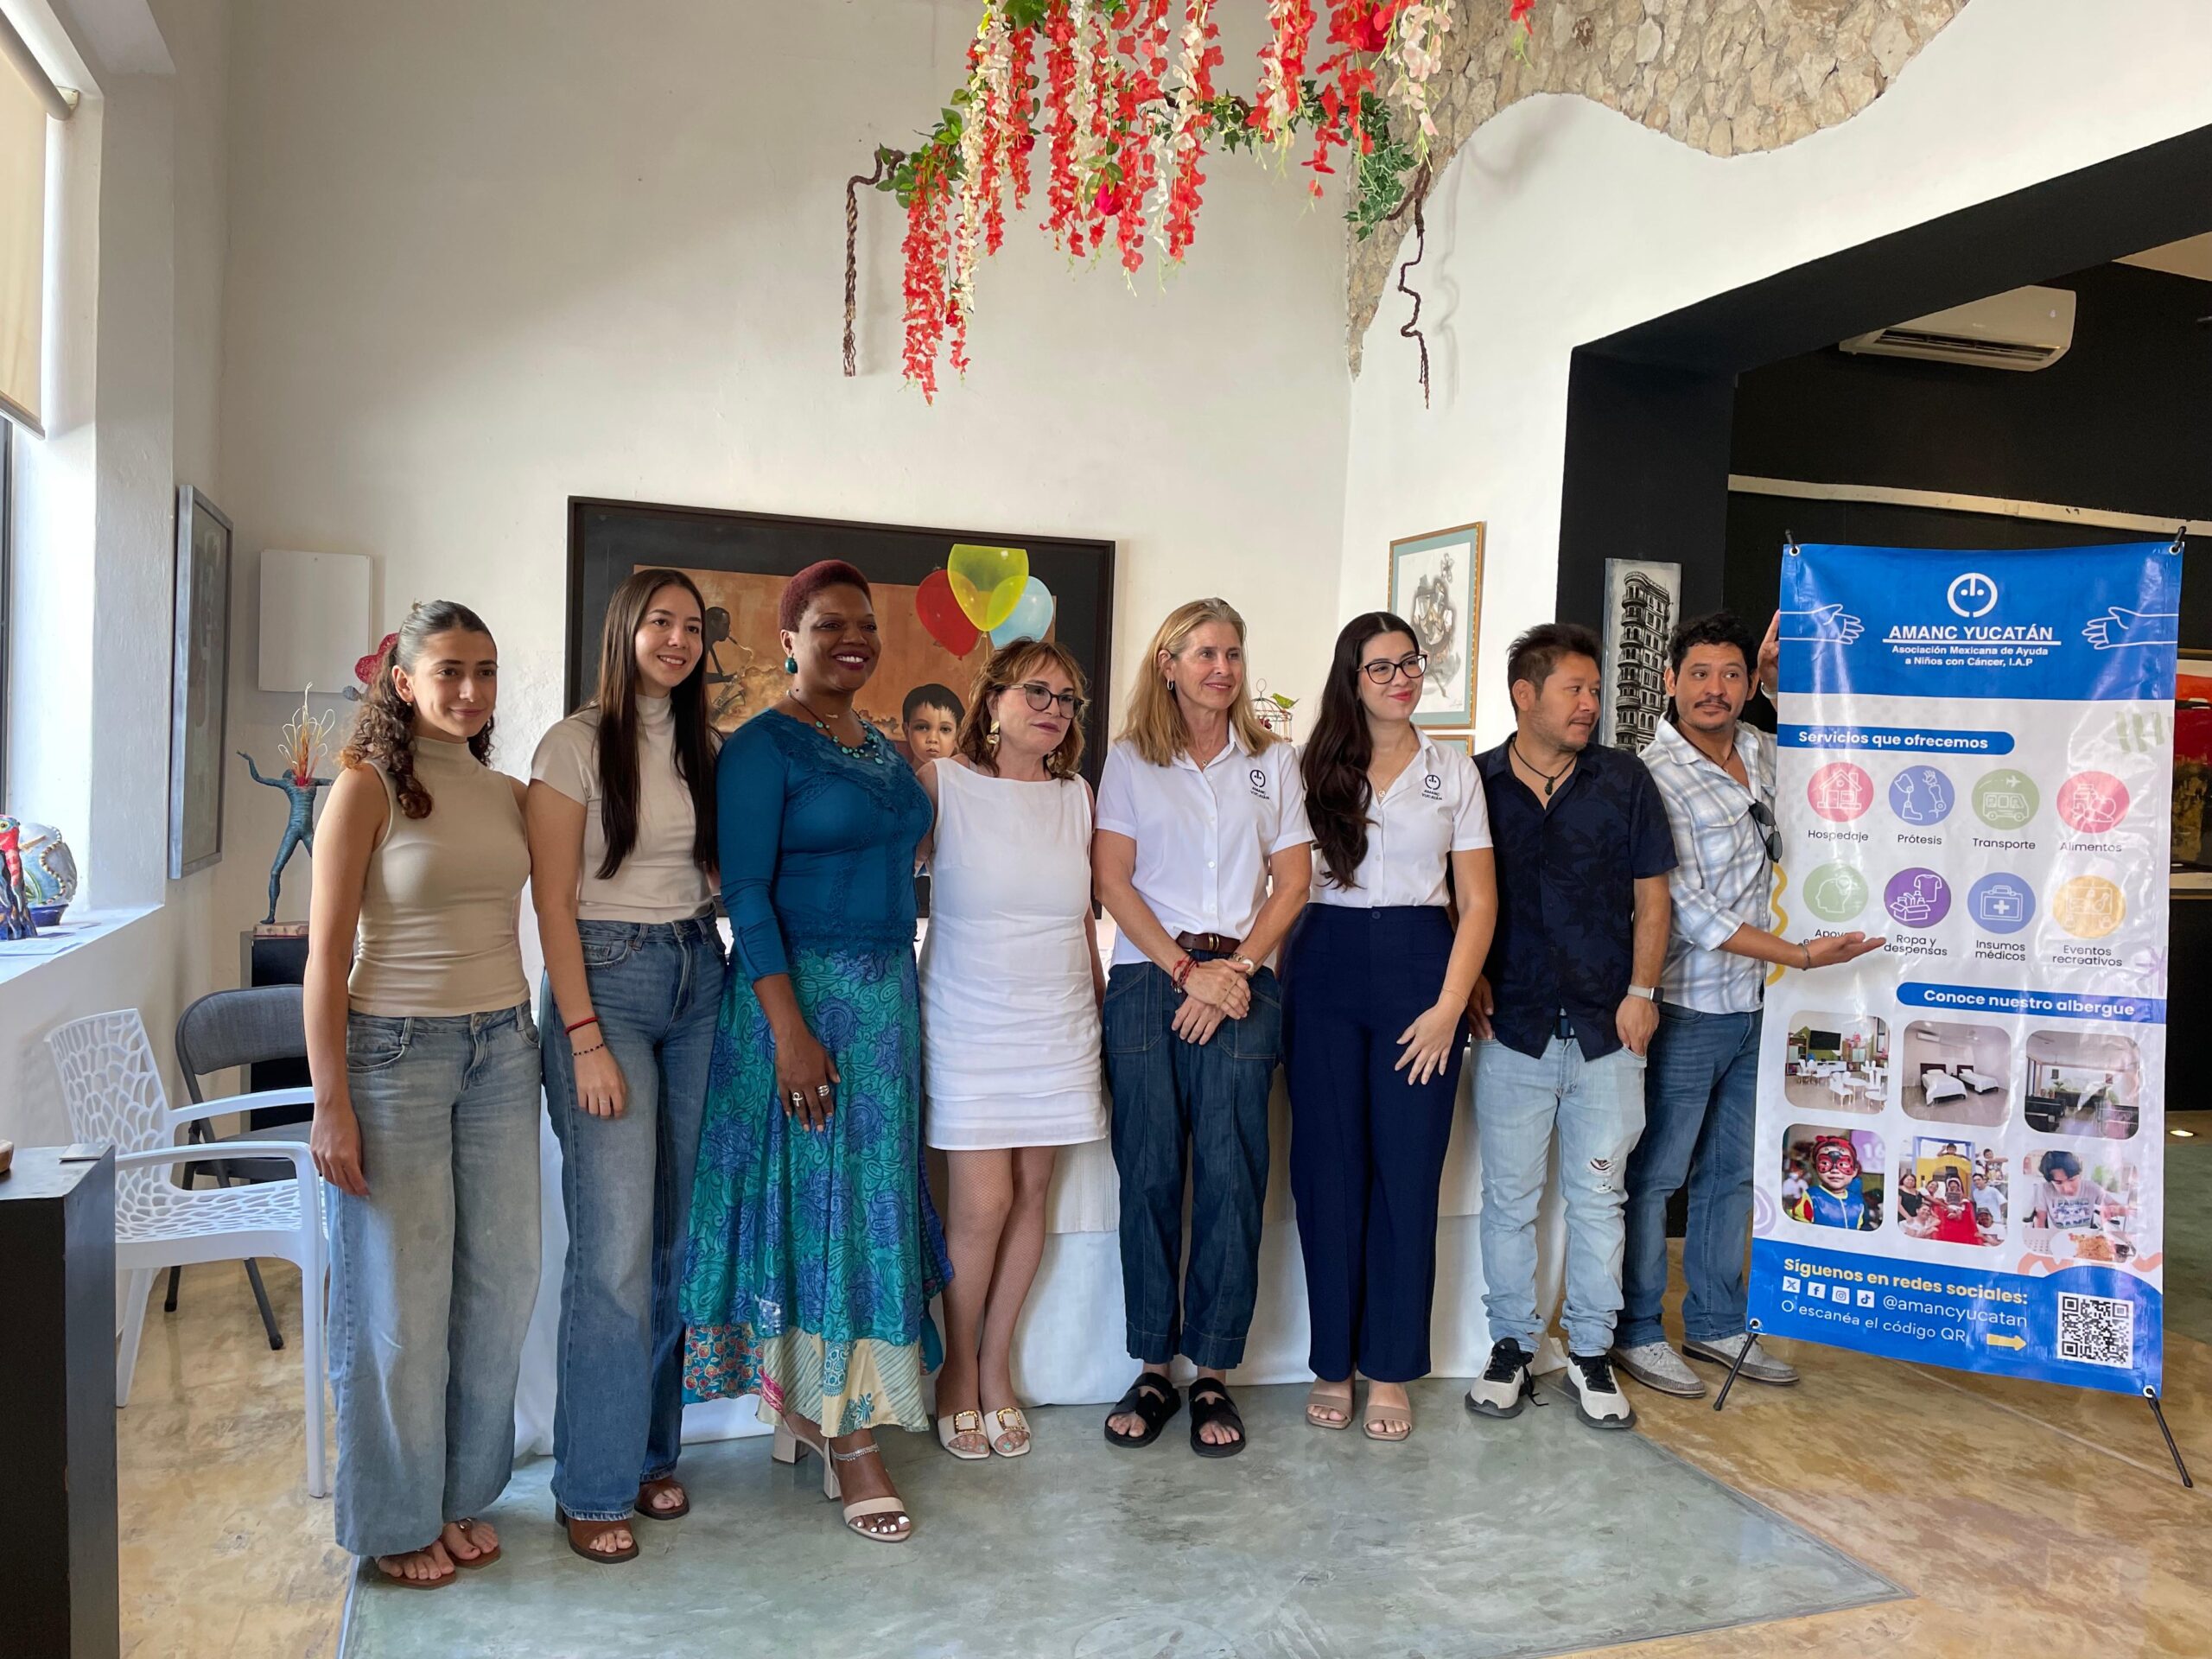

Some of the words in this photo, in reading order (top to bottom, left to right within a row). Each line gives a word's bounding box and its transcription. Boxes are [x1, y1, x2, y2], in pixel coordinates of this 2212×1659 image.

[1889, 626, 1957, 640] AMANC
[1963, 624, 2053, 641] YUCATÁN
[1891, 645, 1947, 655] Asociación
[1950, 646, 1998, 655] Mexicana
[2000, 646, 2014, 656] de
[2016, 647, 2049, 658] Ayuda
[1914, 657, 1942, 666] Niños
[1967, 658, 2006, 667] Cáncer,
[2009, 658, 2033, 667] I.A.P
[1798, 731, 1869, 744] Servicios
[1872, 734, 1902, 748] que
[1904, 734, 1988, 749] ofrecemos
[1808, 830, 1869, 842] Hospedaje
[1897, 834, 1942, 845] Prótesis
[1973, 837, 2036, 850] Transporte
[2060, 842, 2122, 852] Alimentos
[1897, 934, 1927, 946] Ropa
[1929, 938, 1936, 947] y
[1976, 939, 2026, 951] Insumos
[1884, 944, 1948, 956] despensas
[1975, 950, 2026, 961] médicos
[2063, 944, 2112, 956] Eventos
[2052, 955, 2122, 967] recreativos
[1923, 989, 1986, 1006] Conoce
[1988, 995, 2053, 1010] nuestro
[2056, 1000, 2135, 1018] albergue
[1783, 1258, 1864, 1281] Síguenos
[1866, 1273, 1889, 1286] en
[1892, 1277, 1942, 1294] redes
[1946, 1284, 2028, 1305] sociales:
[1883, 1295, 2027, 1328] @amancyucatan
[1781, 1300, 1795, 1313] O
[1798, 1306, 1860, 1325] escanéa
[1865, 1317, 1878, 1329] el
[1882, 1319, 1936, 1340] código
[1941, 1327, 1966, 1343] QR
